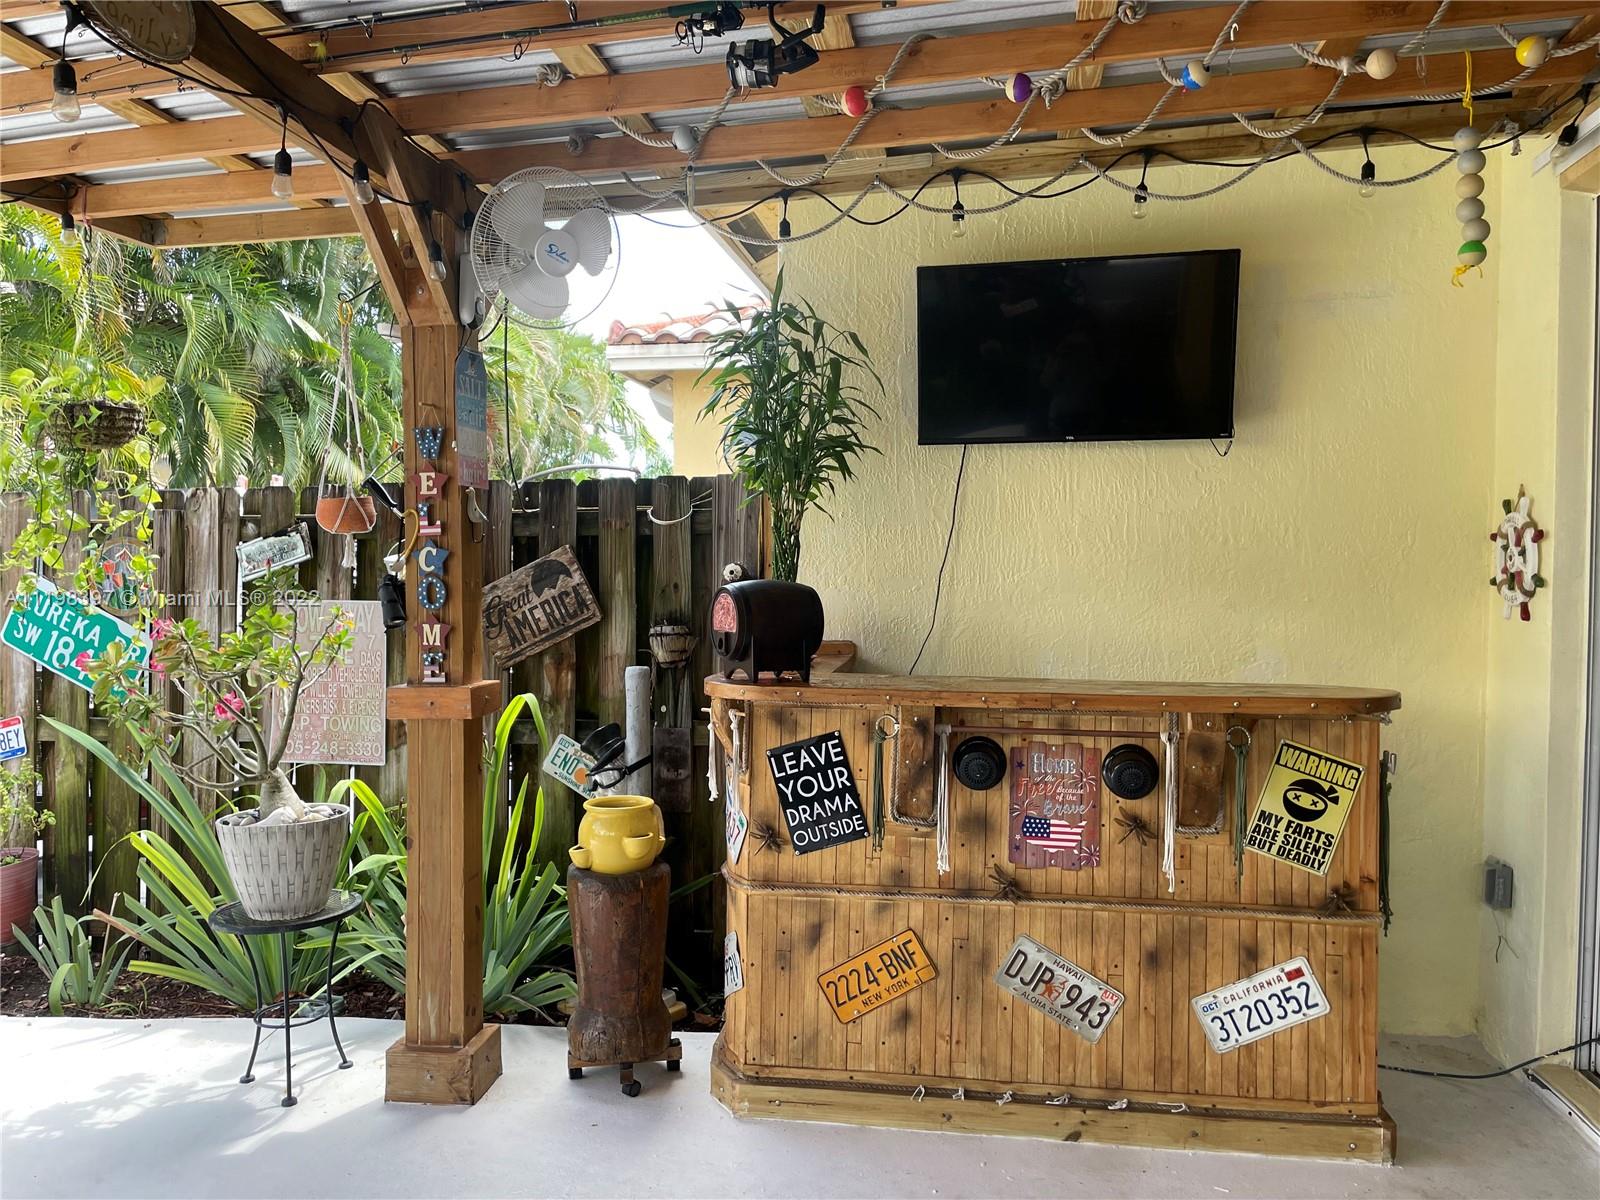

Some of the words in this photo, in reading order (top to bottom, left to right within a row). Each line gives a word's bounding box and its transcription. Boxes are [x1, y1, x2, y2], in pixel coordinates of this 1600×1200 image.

[413, 427, 451, 684] WELCOME
[14, 614, 42, 646] SW
[483, 586, 532, 640] Great
[504, 582, 592, 650] AMERICA
[360, 651, 383, 667] DAYS
[320, 716, 382, 733] TOWING
[771, 739, 844, 778] LEAVE
[1280, 745, 1359, 790] WARNING
[778, 766, 851, 803] YOUR
[1066, 793, 1077, 801] the
[786, 792, 858, 827] DRAMA
[793, 814, 865, 846] OUTSIDE
[1251, 823, 1280, 842] ARE
[1282, 833, 1331, 859] SILENT
[1257, 810, 1284, 828] MY
[1284, 820, 1335, 848] FARTS
[1248, 834, 1276, 853] BUT
[1276, 843, 1326, 870] DEADLY
[826, 938, 917, 1008] 2224-BNF
[1004, 948, 1055, 993] DJP
[1060, 983, 1111, 1029] 943
[1053, 958, 1085, 983] HAWAII
[861, 992, 883, 1008] NEW
[884, 977, 911, 996] YORK
[1021, 991, 1047, 1010] ALOHA
[1047, 1006, 1073, 1026] STATE
[1202, 1002, 1219, 1014] OCT
[1223, 974, 1285, 1005] CALIFORNIA
[1210, 981, 1320, 1042] 3T20352
